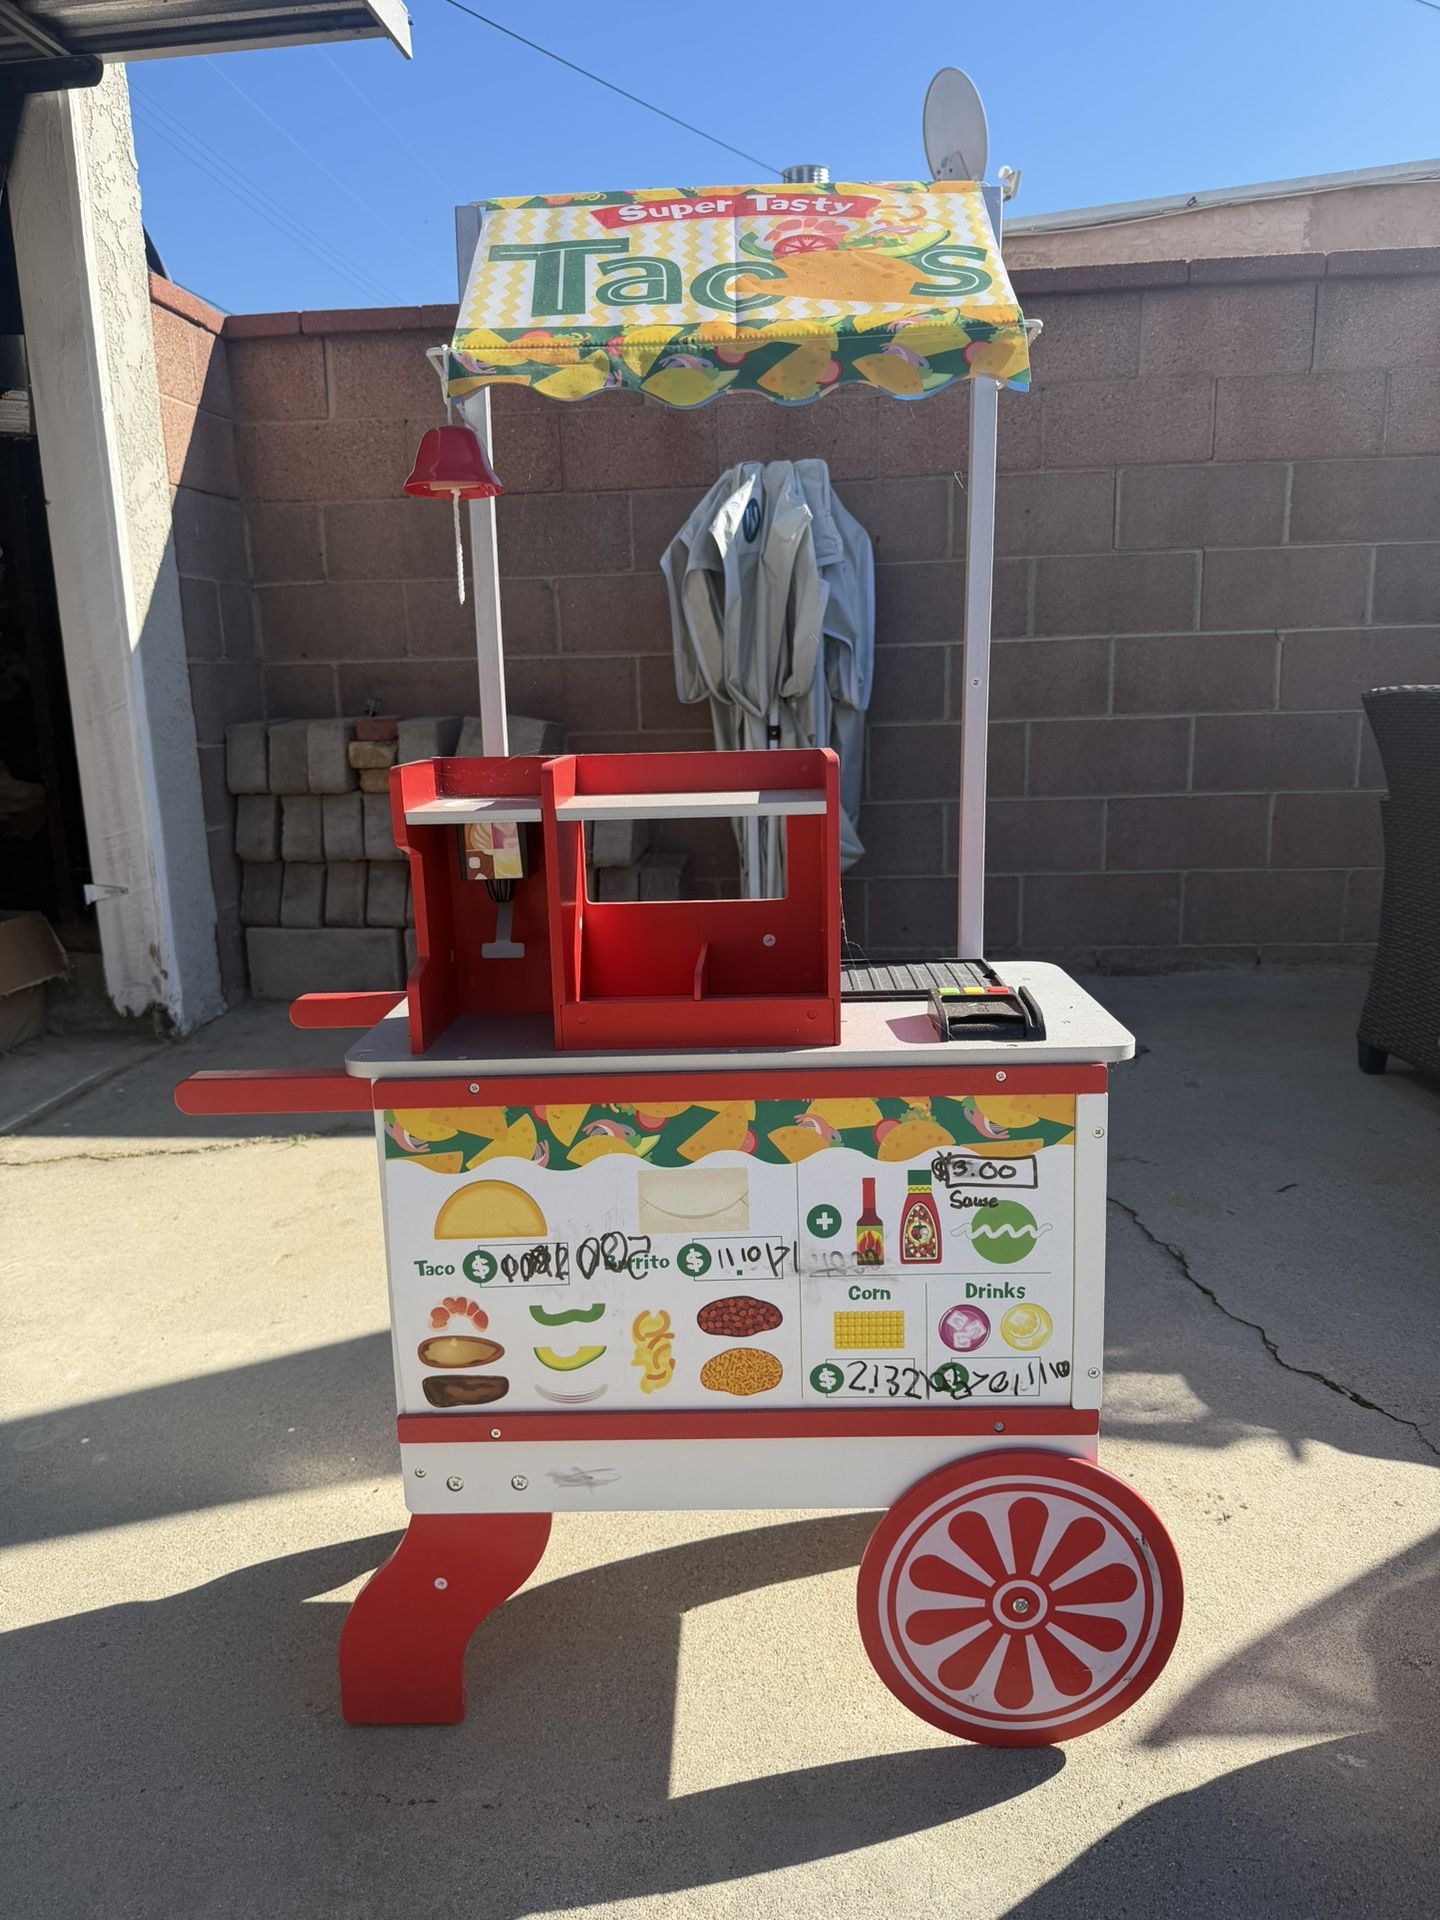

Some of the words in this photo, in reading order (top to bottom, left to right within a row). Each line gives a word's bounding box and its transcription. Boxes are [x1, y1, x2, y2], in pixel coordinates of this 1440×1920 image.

[618, 199, 733, 222] Super
[745, 194, 853, 216] Tasty
[488, 237, 990, 318] Tacs
[413, 1260, 456, 1277] Taco
[848, 1285, 892, 1301] Corn
[965, 1282, 1026, 1300] Drinks
